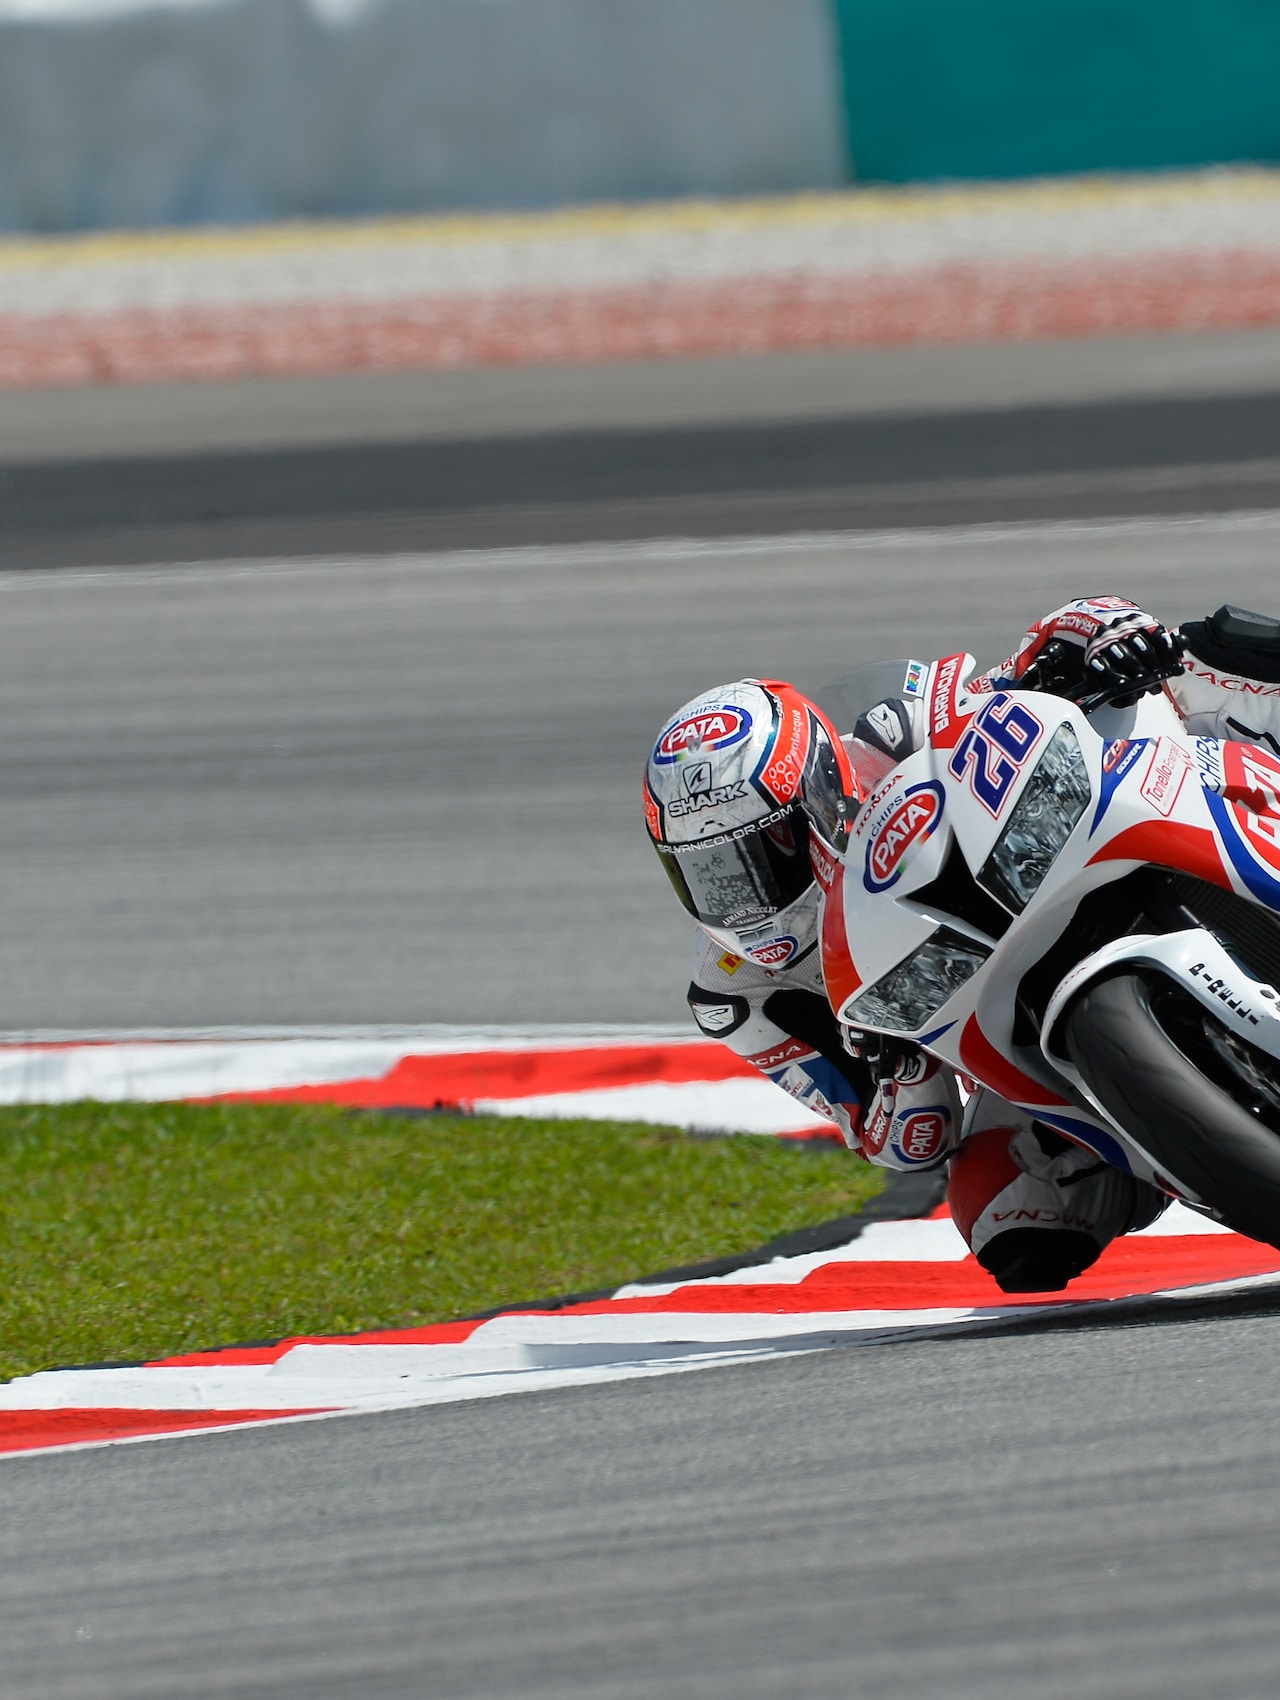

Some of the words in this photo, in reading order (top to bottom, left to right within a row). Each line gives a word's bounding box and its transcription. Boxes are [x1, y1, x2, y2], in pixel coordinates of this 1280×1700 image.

[681, 704, 722, 721] CHIPS
[935, 657, 960, 734] BARRACUDA
[667, 713, 727, 749] PATA
[948, 691, 1044, 820] 26
[1196, 735, 1220, 794] CHIPS
[668, 779, 749, 818] SHARK
[1146, 764, 1172, 802] Tonello
[856, 774, 904, 836] HONDA
[871, 796, 903, 837] CHIPS
[873, 802, 930, 872] PATA
[752, 939, 774, 950] CHIPS
[752, 946, 789, 961] PATA
[1188, 963, 1259, 1025] PIRELLI
[890, 1120, 903, 1144] CHIPS
[909, 1120, 936, 1155] PATA
